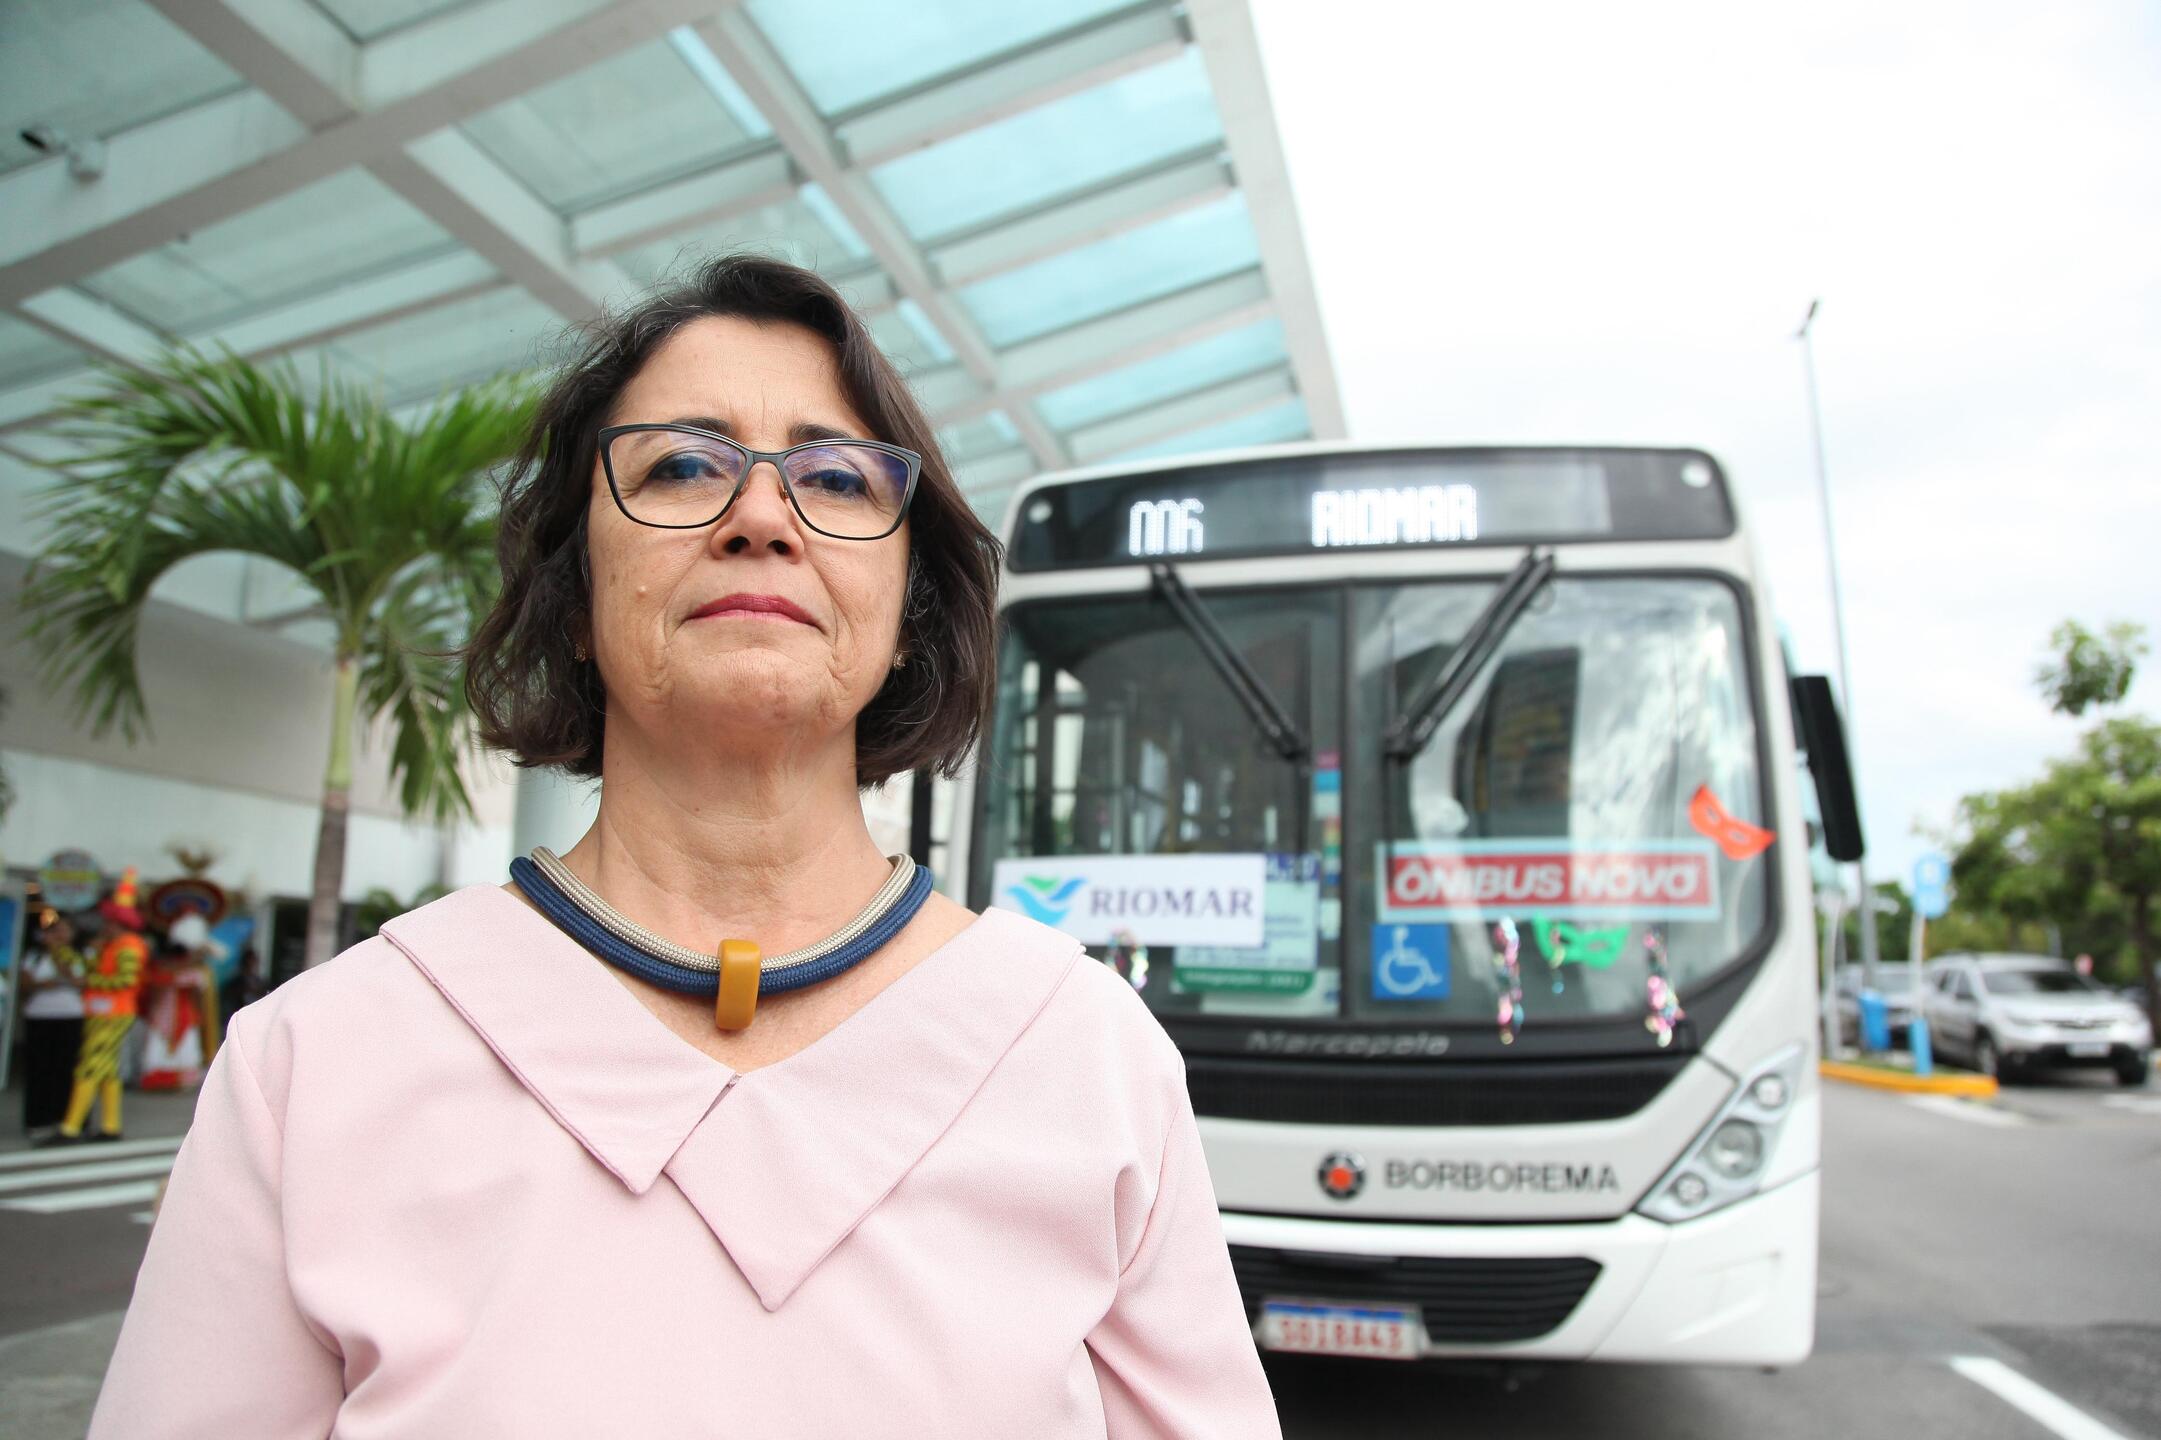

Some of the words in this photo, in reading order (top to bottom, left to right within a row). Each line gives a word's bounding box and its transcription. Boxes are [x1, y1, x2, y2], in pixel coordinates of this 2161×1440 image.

[1312, 484, 1478, 547] RIOMAR
[1394, 861, 1564, 902] ÔNIBUS
[1570, 860, 1700, 901] NOVO
[1089, 886, 1254, 919] RIOMAR
[1385, 1160, 1619, 1192] BORBOREMA
